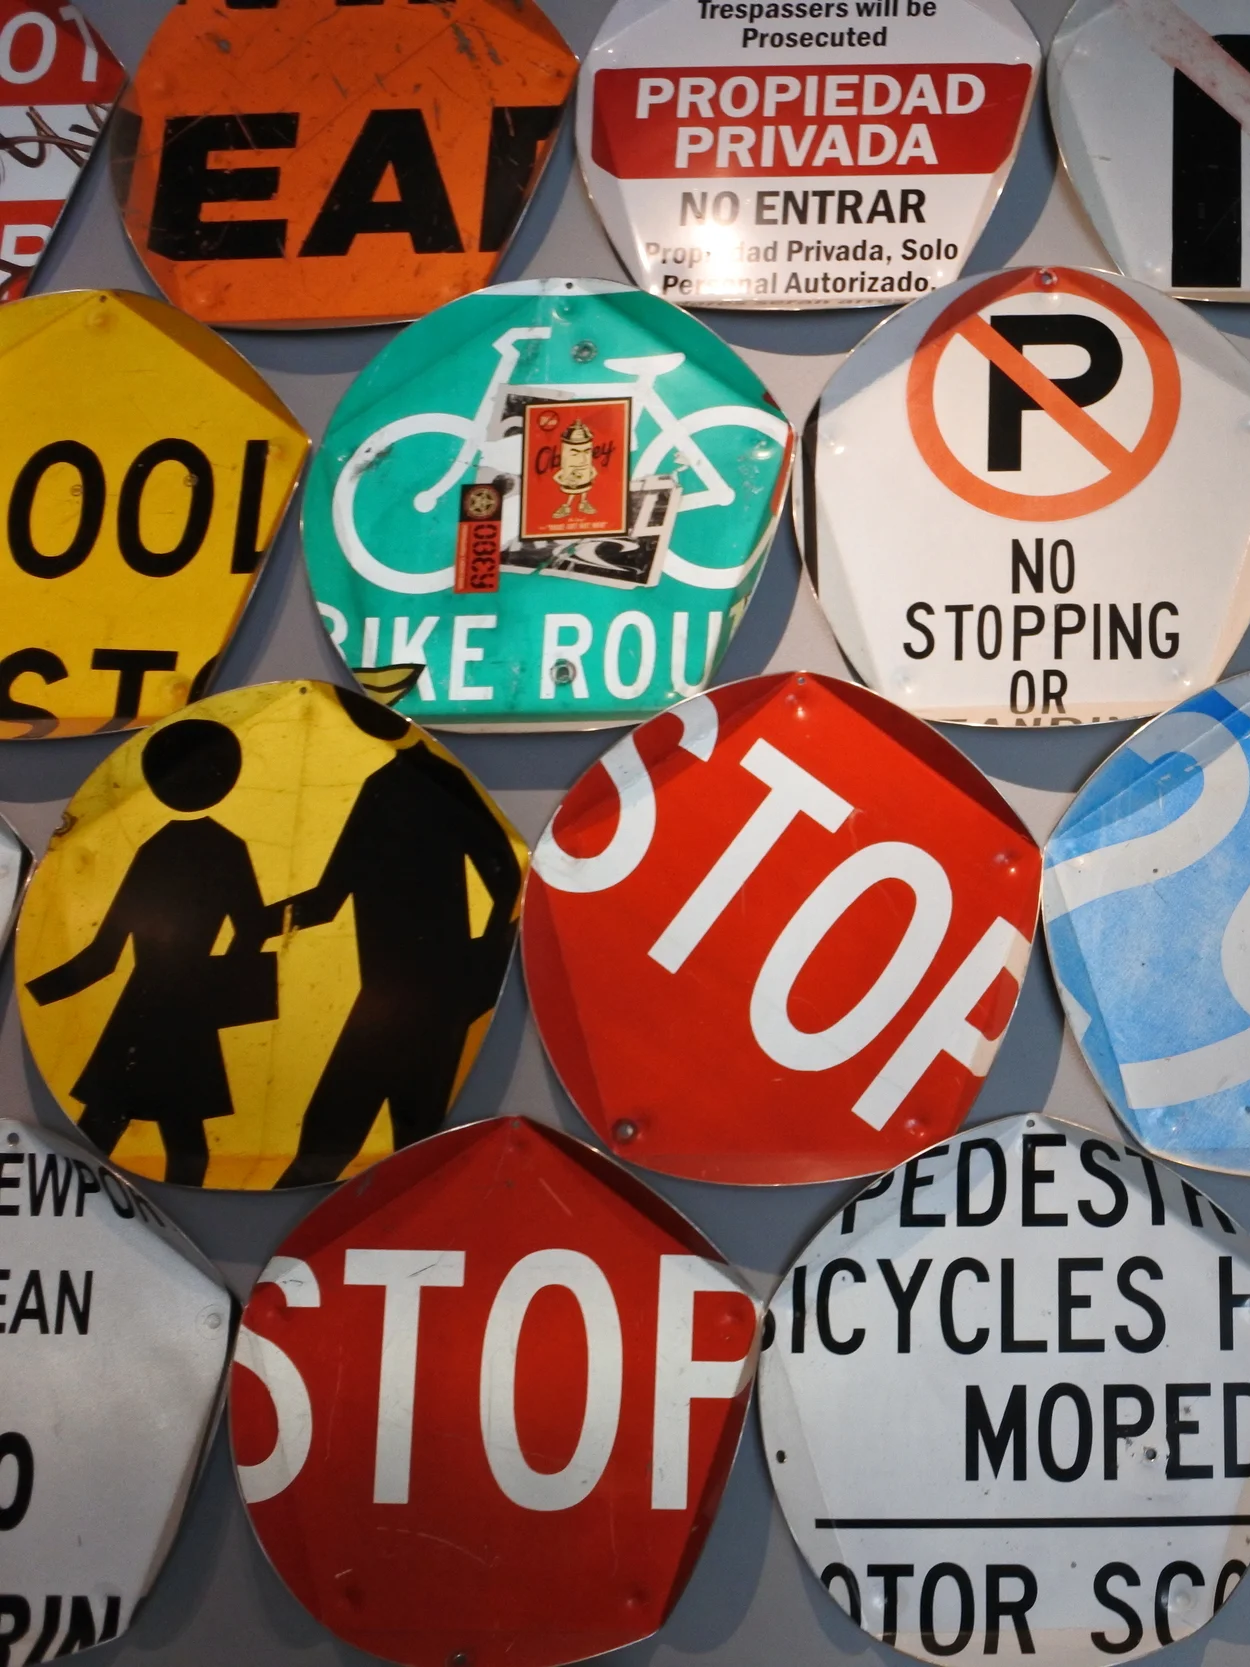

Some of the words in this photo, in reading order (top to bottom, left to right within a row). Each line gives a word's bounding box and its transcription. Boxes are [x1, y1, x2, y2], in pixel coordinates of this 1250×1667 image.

[698, 0, 849, 23] Trespassers
[855, 0, 898, 17] will
[906, 0, 937, 17] be
[741, 26, 888, 49] Prosecuted
[634, 73, 986, 119] PROPIEDAD
[674, 123, 939, 169] PRIVADA
[679, 189, 740, 227] NO
[754, 188, 927, 227] ENTRAR
[645, 240, 778, 268] Propad
[786, 239, 893, 265] Privada,
[900, 238, 959, 262] Solo
[661, 272, 778, 295] Penal
[784, 270, 937, 294] Autorizado.
[988, 313, 1123, 472] P
[1010, 538, 1076, 595] NO
[902, 600, 1181, 662] STOPPING
[0, 647, 221, 739] ST
[1009, 668, 1068, 715] OR
[229, 1248, 765, 1512] STOP
